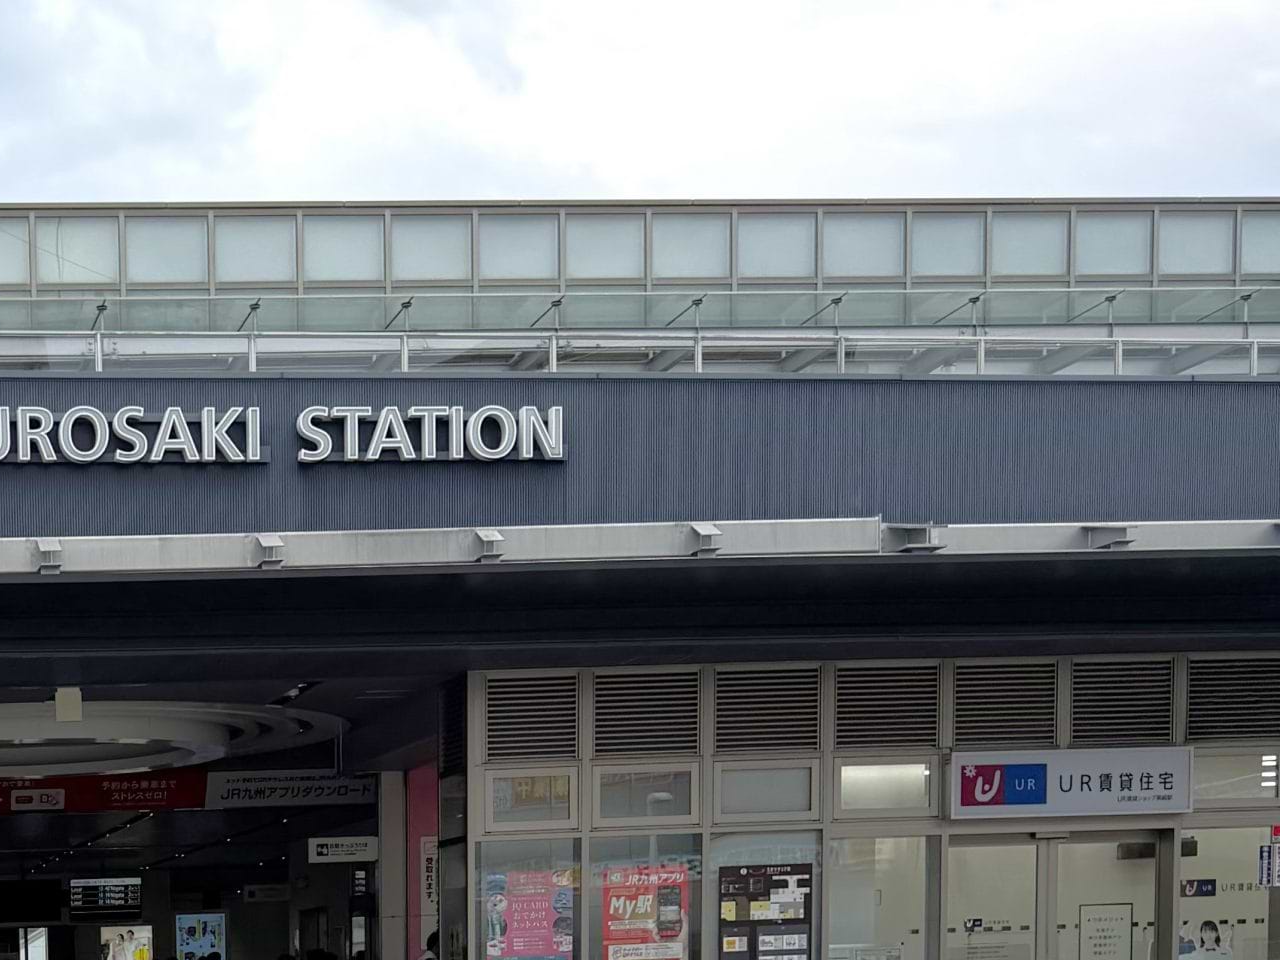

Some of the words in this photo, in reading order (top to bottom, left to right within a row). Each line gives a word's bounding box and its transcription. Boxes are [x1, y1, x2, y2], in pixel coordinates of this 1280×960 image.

[296, 403, 565, 463] STATION
[1015, 778, 1036, 791] UR
[1058, 771, 1175, 793] UR賃貸住宅
[220, 784, 371, 800] JR九州アプリダウンロード
[624, 872, 685, 886] JR九州アプリ
[609, 894, 654, 919] My駅
